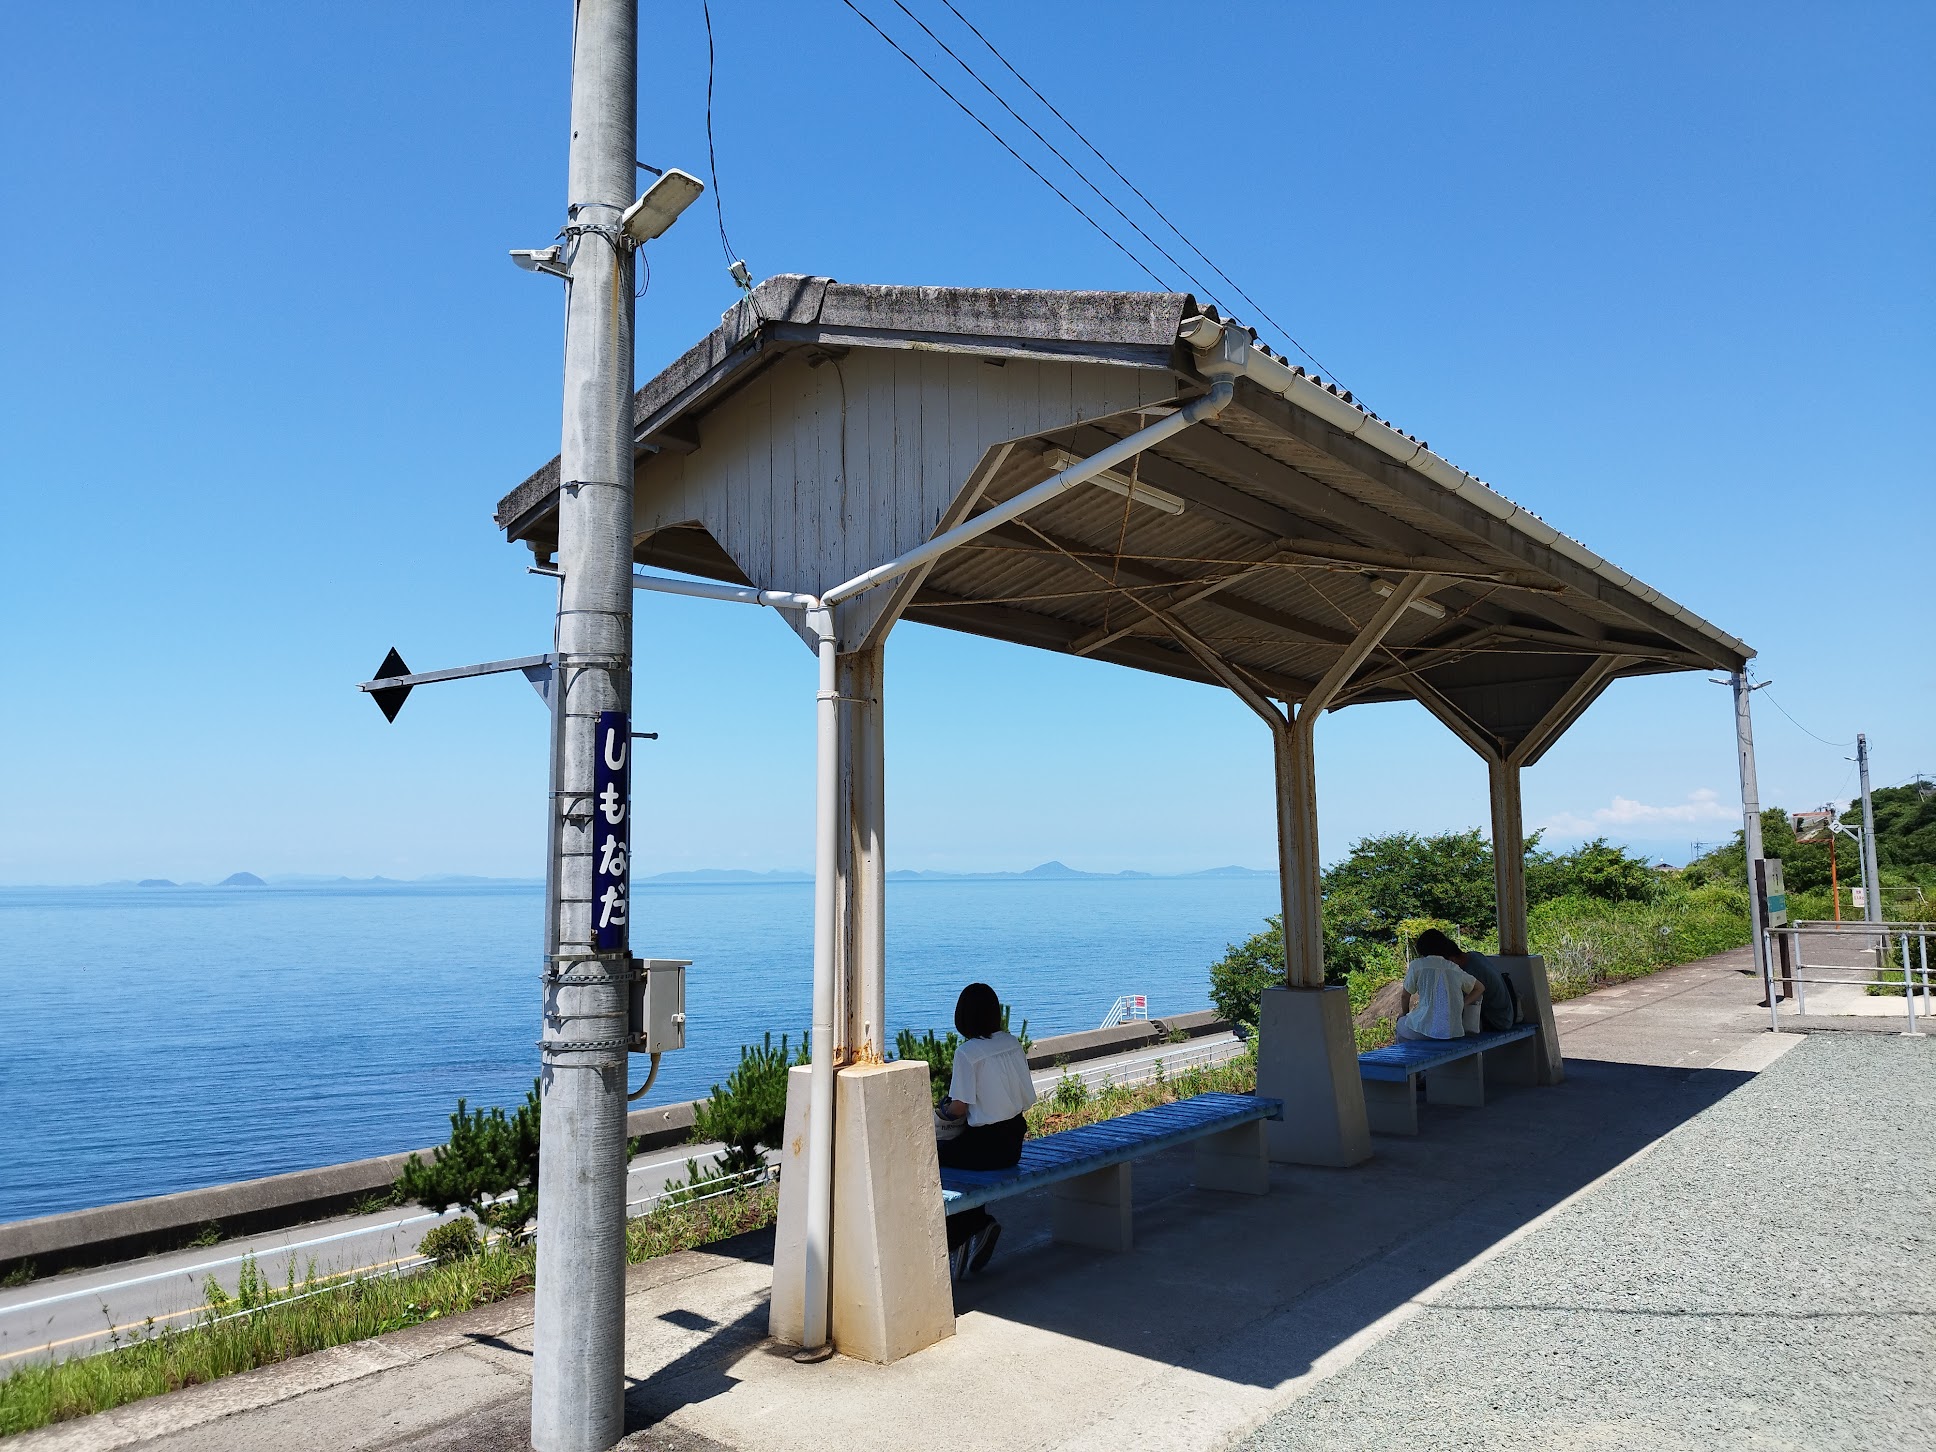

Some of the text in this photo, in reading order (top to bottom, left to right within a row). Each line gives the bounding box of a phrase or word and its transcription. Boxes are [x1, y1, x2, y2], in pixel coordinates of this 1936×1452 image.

[599, 727, 626, 929] しもなだ
[1833, 823, 1840, 831] 2
